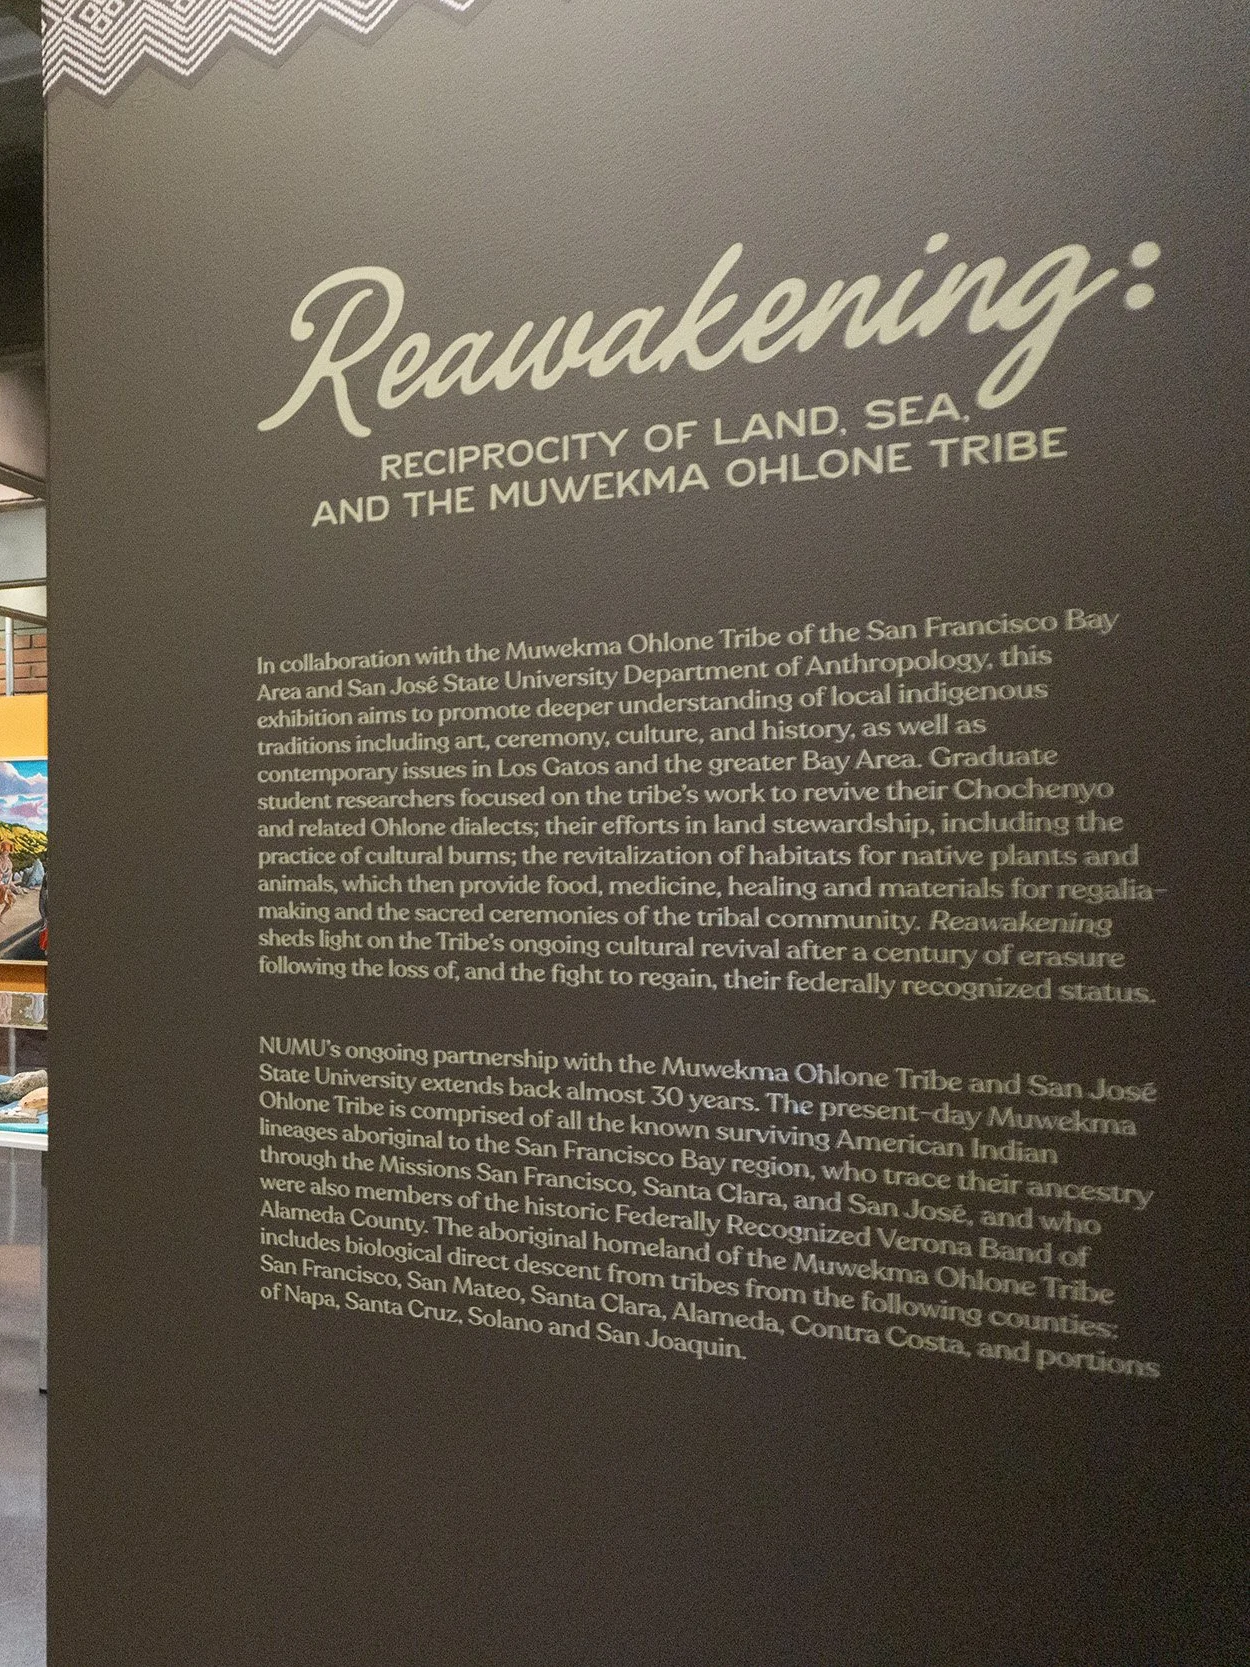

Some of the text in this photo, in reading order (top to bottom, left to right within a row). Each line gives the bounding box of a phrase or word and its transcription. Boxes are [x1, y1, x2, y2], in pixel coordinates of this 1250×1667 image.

[256, 232, 1162, 439] Reawakening:
[380, 392, 970, 482] RECIPROCITY OF LAND, SEA,
[311, 426, 1068, 528] AND THE MUWEKMA OHLONE TRIBE
[256, 607, 1120, 675] In collaboration with the Muwekma Ohlone Tribe of the San Francisco Bay
[256, 644, 1053, 702] Area and San José State University Department of Anthropology, this
[256, 744, 1059, 787] contemporary issues in Los Gatos and the greater Bay Area. Graduate
[257, 809, 1124, 839] and related Ohlone dialects; their efforts in land stewardship, including the
[257, 842, 1139, 872] practice of cultural burns; the revitalization of habitats for native plants and
[257, 900, 1113, 939] making and the sacred ceremonies of the tribal community. Reawakening
[258, 954, 1157, 1004] following the loss of, and the fight to regain, their federally recognized status.
[344, 1042, 429, 1067] ongoing
[432, 1047, 560, 1075] partnership
[562, 1051, 614, 1073] with
[617, 1053, 657, 1076] the
[661, 1055, 790, 1083] Muwekma
[793, 1062, 890, 1089] Ohlone
[893, 1066, 963, 1093] Tribe
[967, 1072, 1021, 1096] and
[1027, 1074, 1084, 1099] San
[1087, 1077, 1158, 1104] José
[258, 1089, 1059, 1165] Ohlone Tribe is comprised of all the known surviving American Indian
[259, 1144, 1102, 1236] through the Missions San Francisco, Santa Clara, and San José, and who
[259, 1199, 1115, 1306] Alameda County. The aboriginal homeland of the Muwekma Ohlone Tribe
[260, 1253, 1161, 1379] San Francisco, San Mateo, Santa Clara, Alameda, Contra Costa, and portions
